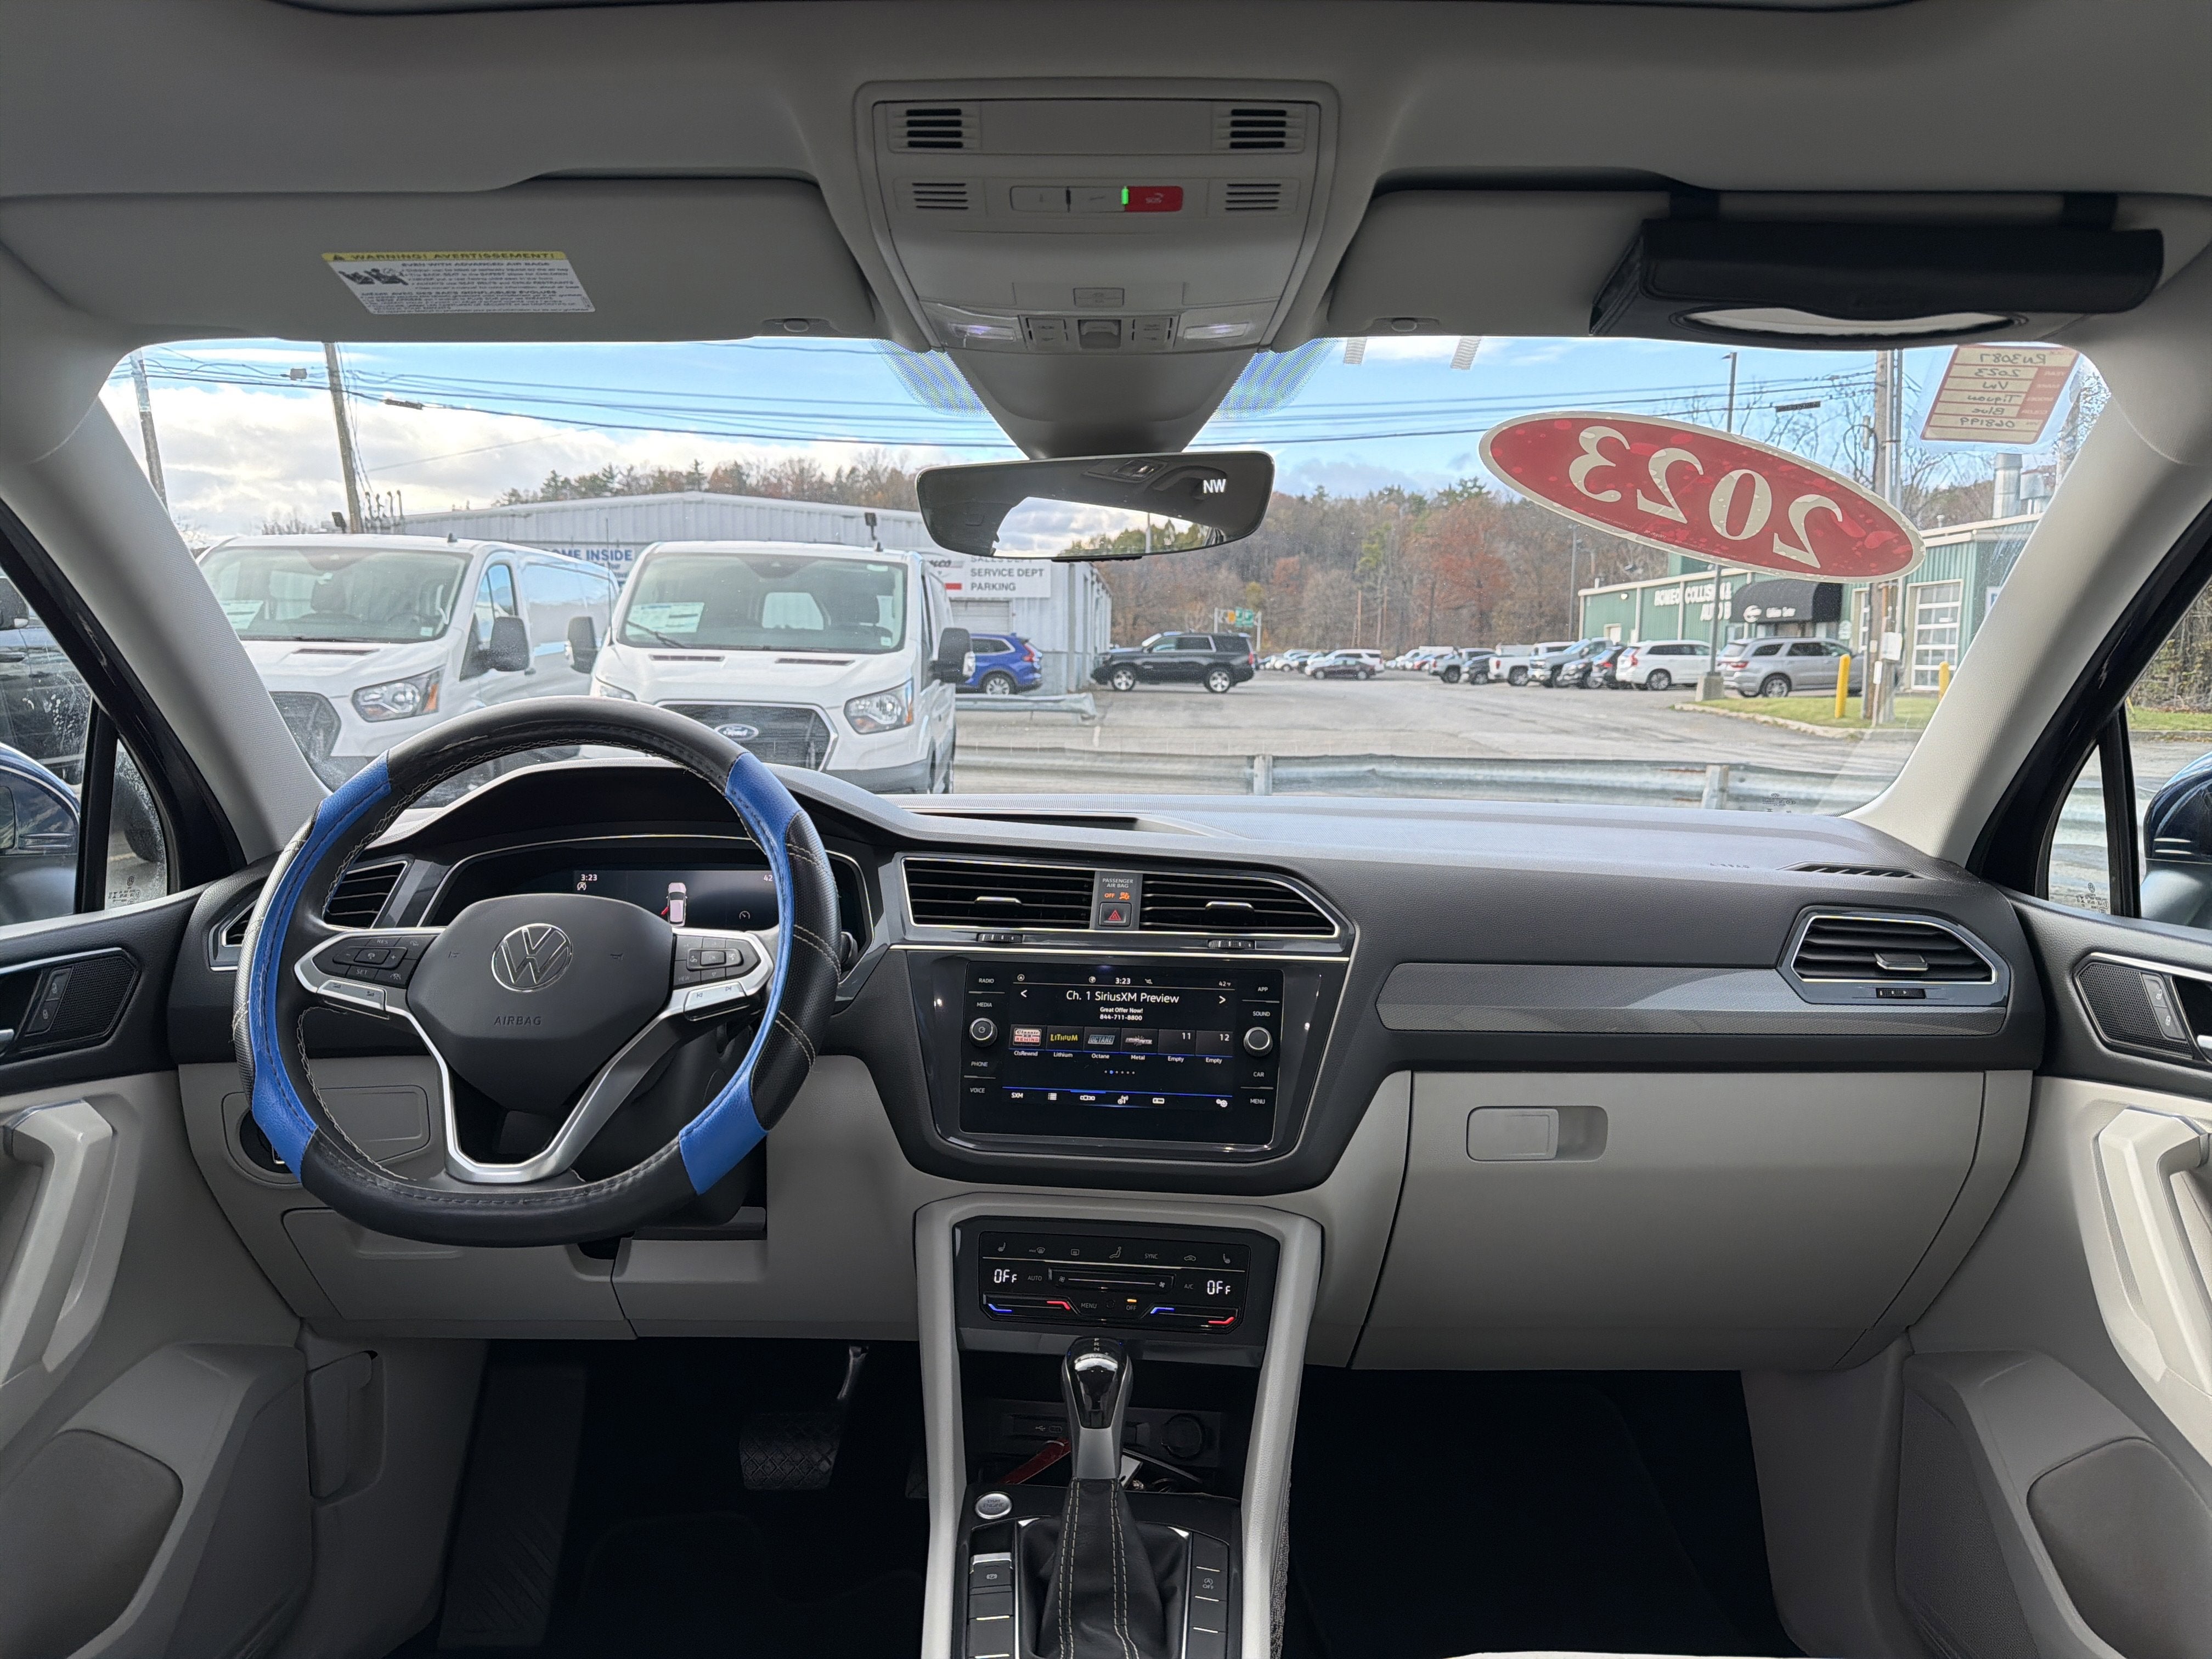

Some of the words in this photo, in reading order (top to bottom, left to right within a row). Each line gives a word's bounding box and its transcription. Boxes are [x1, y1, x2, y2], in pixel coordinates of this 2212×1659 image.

[1203, 478, 1227, 493] NW
[585, 550, 633, 561] INSIDE
[970, 568, 1014, 578] SERVICE
[1017, 568, 1045, 577] DEPT
[970, 582, 1016, 591] PARKING
[1066, 990, 1082, 1001] Ch.
[1086, 991, 1091, 1001] 1
[1095, 991, 1137, 1002] SiriusXM
[1140, 993, 1180, 1003] Preview
[494, 1016, 542, 1026] AIRBAG
[1182, 1032, 1191, 1040] 11
